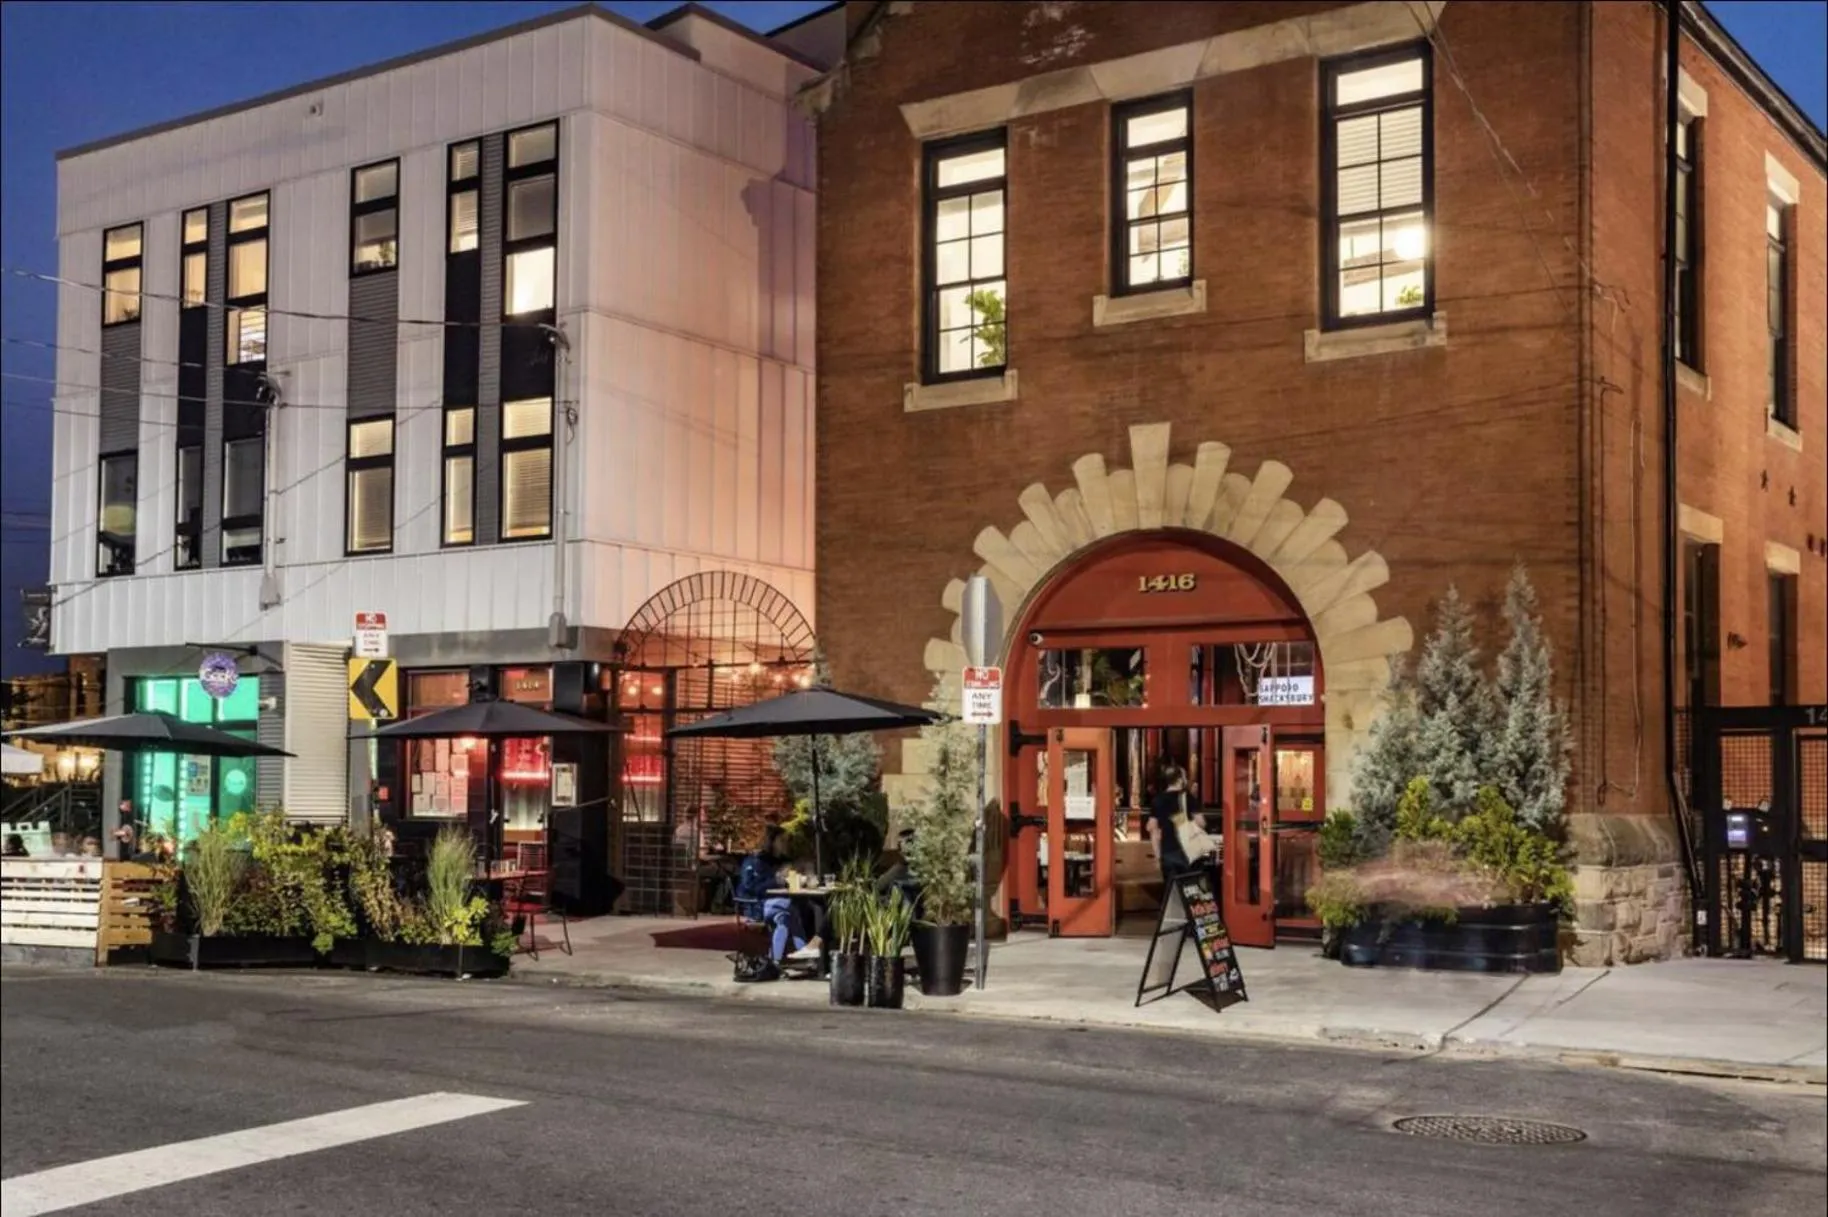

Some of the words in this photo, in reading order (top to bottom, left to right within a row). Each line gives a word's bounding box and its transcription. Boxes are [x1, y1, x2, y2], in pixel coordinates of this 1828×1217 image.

[1138, 574, 1196, 592] 1416
[974, 669, 989, 680] NO
[971, 692, 992, 700] ANY
[971, 701, 992, 710] TIME
